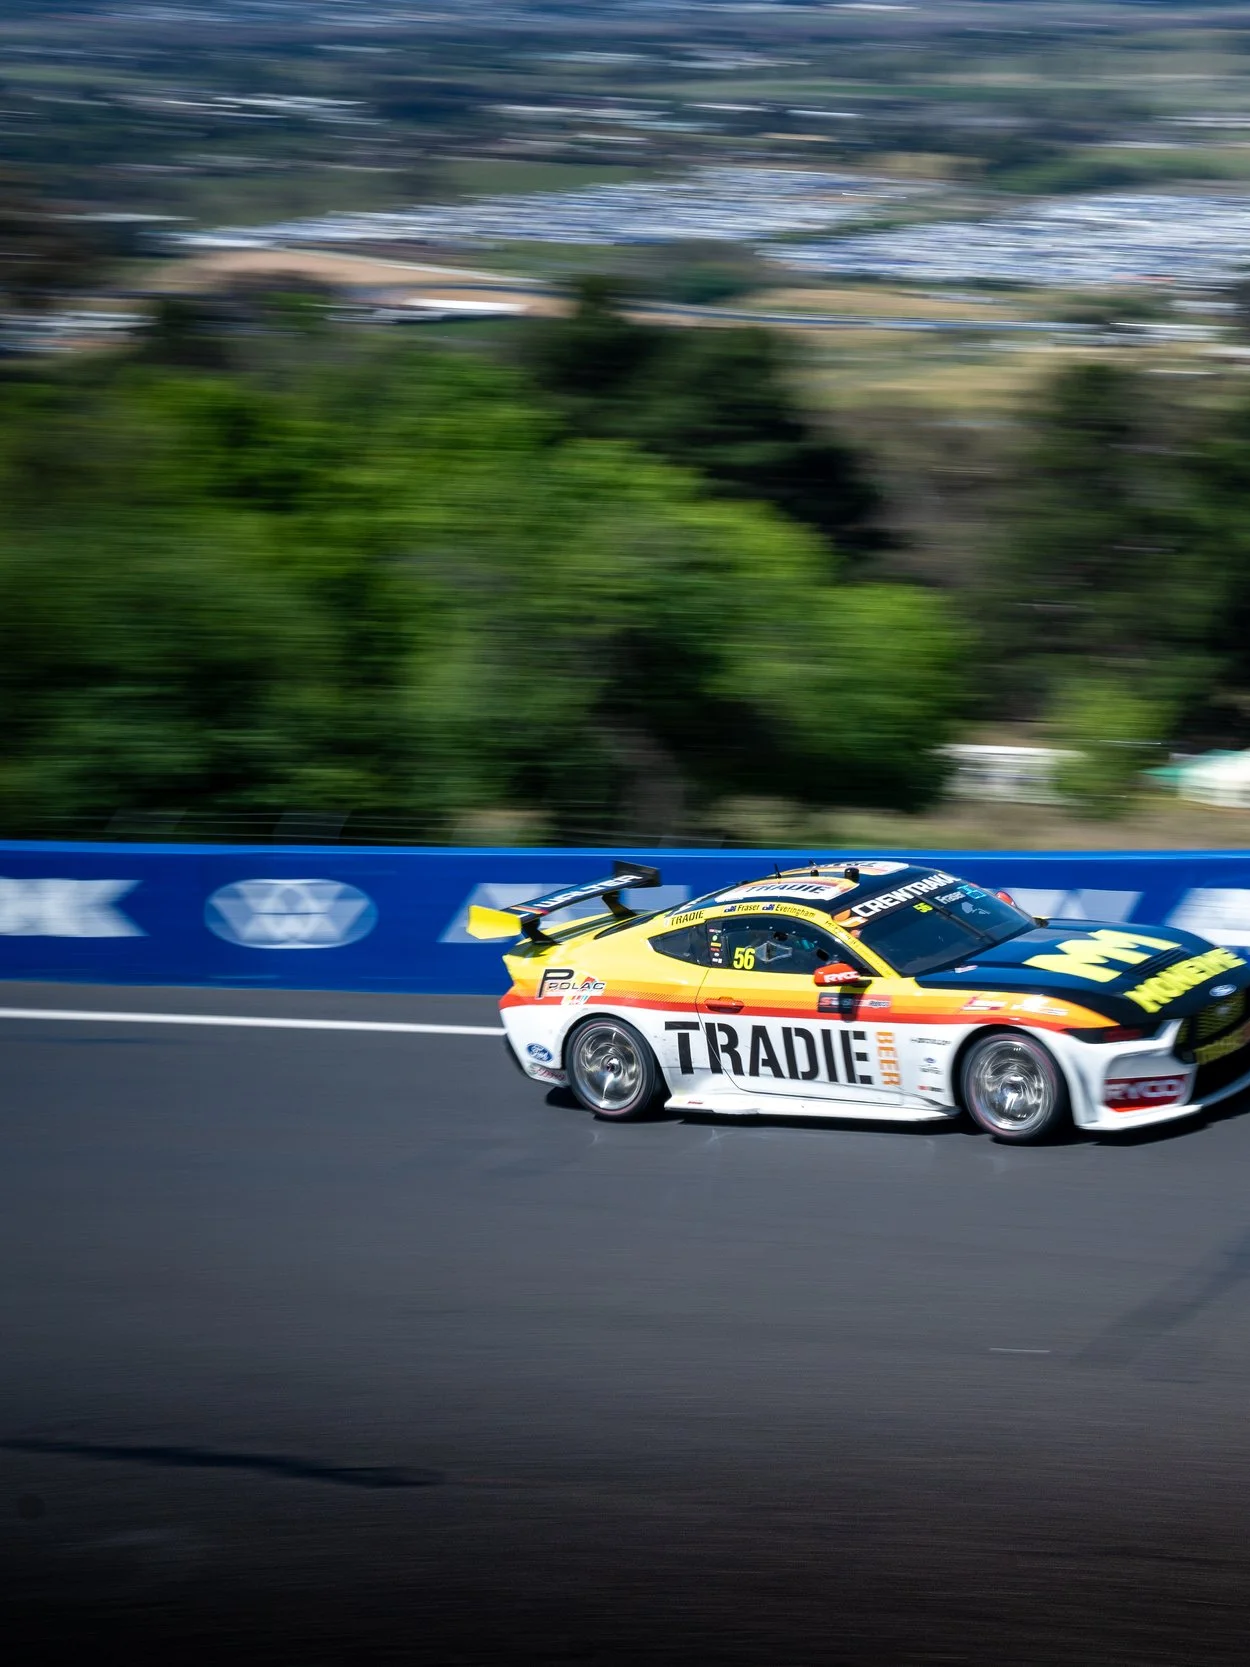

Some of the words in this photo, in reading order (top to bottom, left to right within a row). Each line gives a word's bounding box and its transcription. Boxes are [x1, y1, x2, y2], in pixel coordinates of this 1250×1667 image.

[534, 874, 644, 908] WALTER
[671, 910, 705, 926] TRADIE
[737, 904, 760, 912] Fraser
[775, 903, 816, 918] Everingham
[733, 947, 756, 970] 56
[538, 969, 606, 998] PROLAC
[665, 1021, 873, 1085] TRADIE
[876, 1031, 901, 1085] BEER
